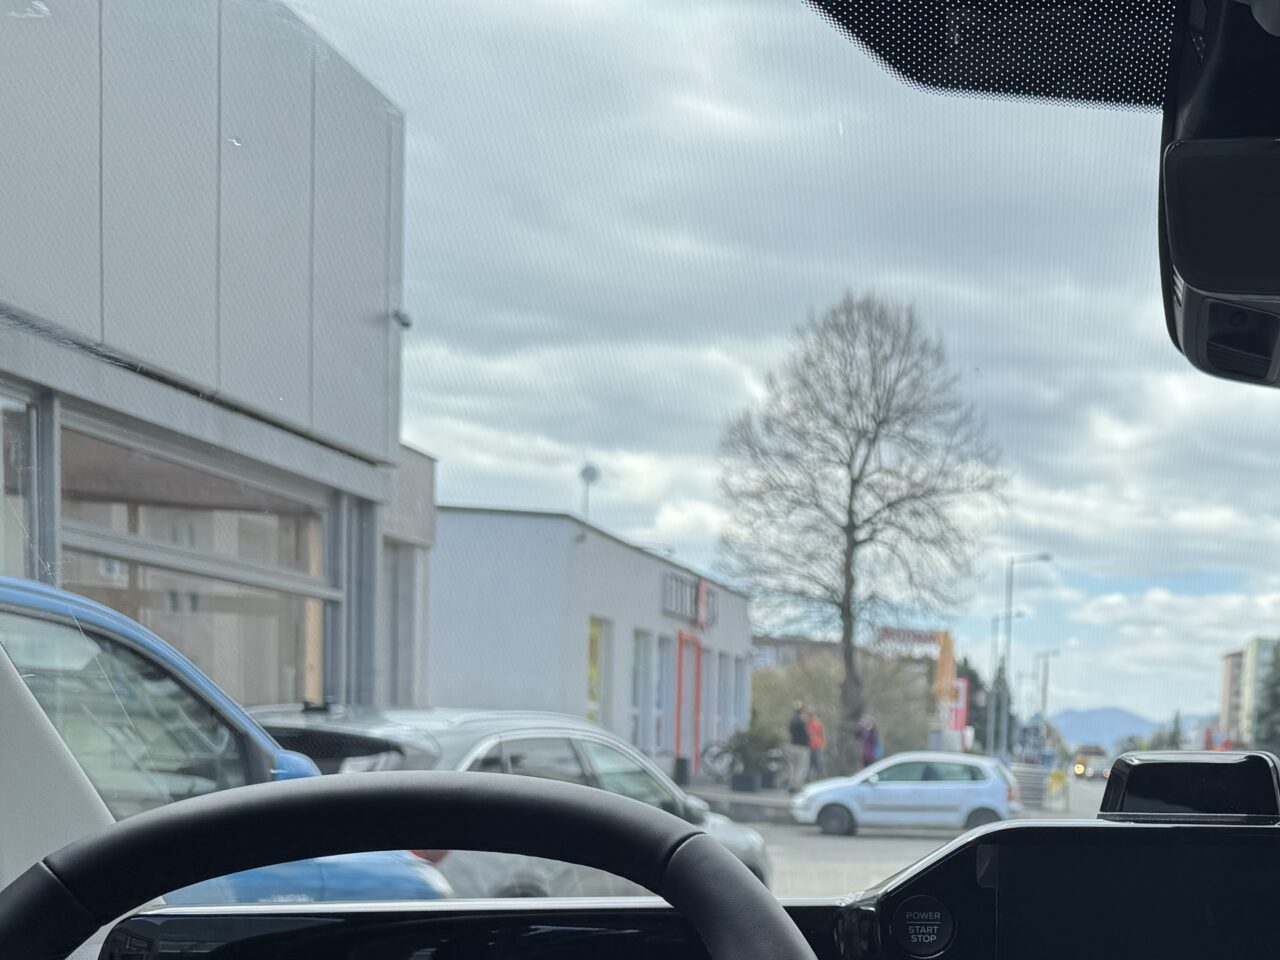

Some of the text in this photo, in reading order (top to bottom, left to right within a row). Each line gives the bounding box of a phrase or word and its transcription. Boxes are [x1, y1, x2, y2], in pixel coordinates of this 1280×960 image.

[906, 911, 941, 920] POWER
[908, 926, 939, 934] START
[911, 935, 937, 943] STOP
